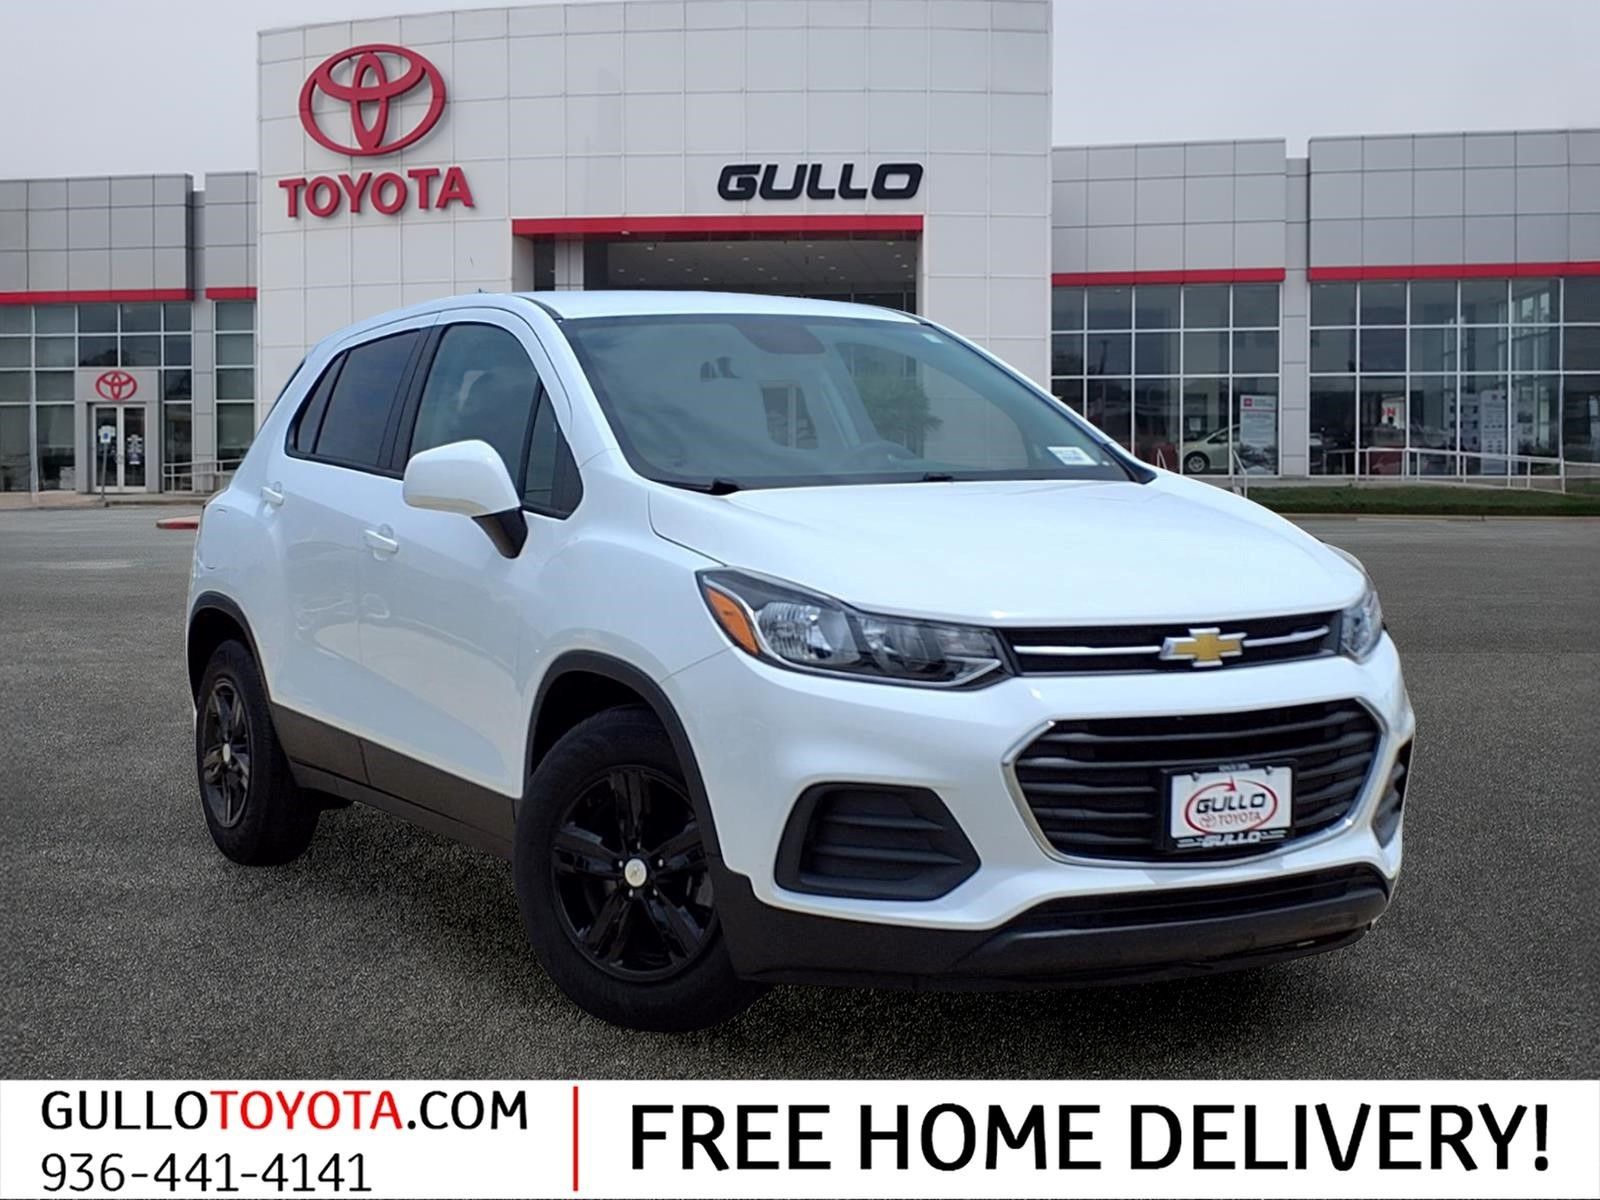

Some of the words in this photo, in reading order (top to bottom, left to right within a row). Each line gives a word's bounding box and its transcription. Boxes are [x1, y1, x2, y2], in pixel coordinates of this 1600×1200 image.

[278, 167, 475, 218] TOYOTA
[717, 163, 924, 201] GULLO
[1197, 793, 1266, 814] GULLO
[1219, 812, 1262, 827] TOYOTA
[1202, 832, 1261, 847] GULLO
